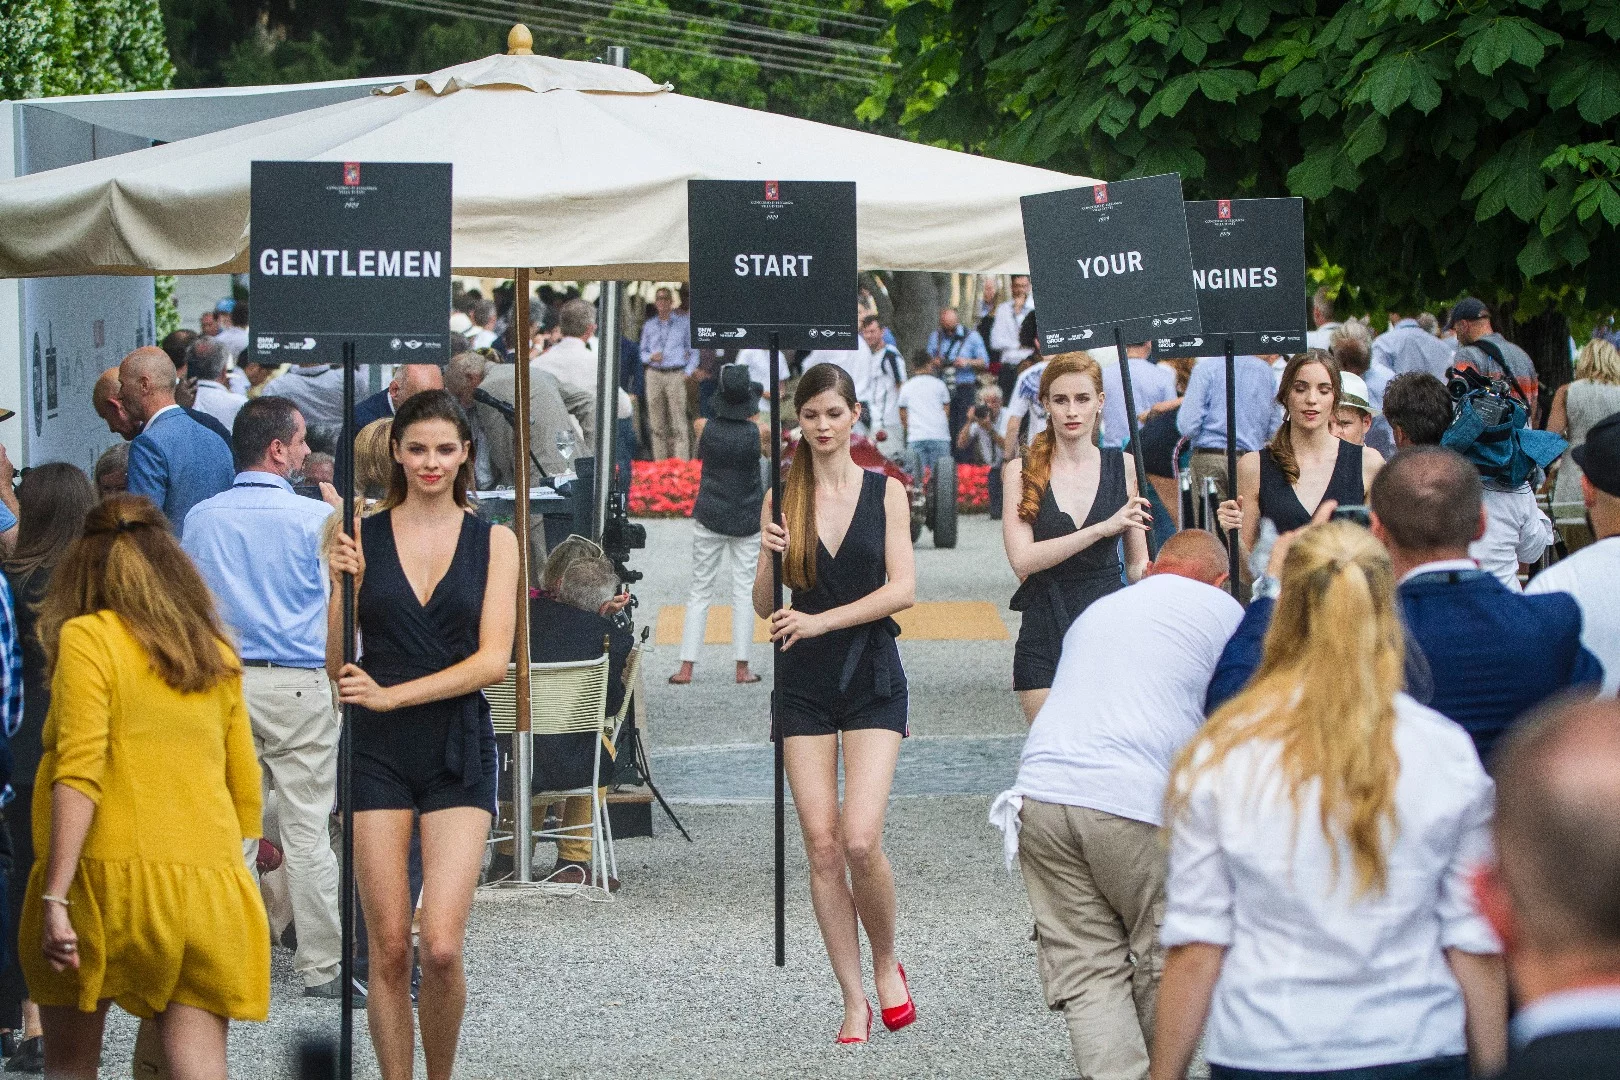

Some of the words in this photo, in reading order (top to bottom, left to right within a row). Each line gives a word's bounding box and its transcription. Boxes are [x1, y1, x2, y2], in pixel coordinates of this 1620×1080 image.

[259, 248, 442, 278] GENTLEMEN
[734, 253, 813, 277] START
[1077, 251, 1144, 279] YOUR
[1192, 266, 1278, 290] NGINES
[257, 342, 280, 350] GROUP
